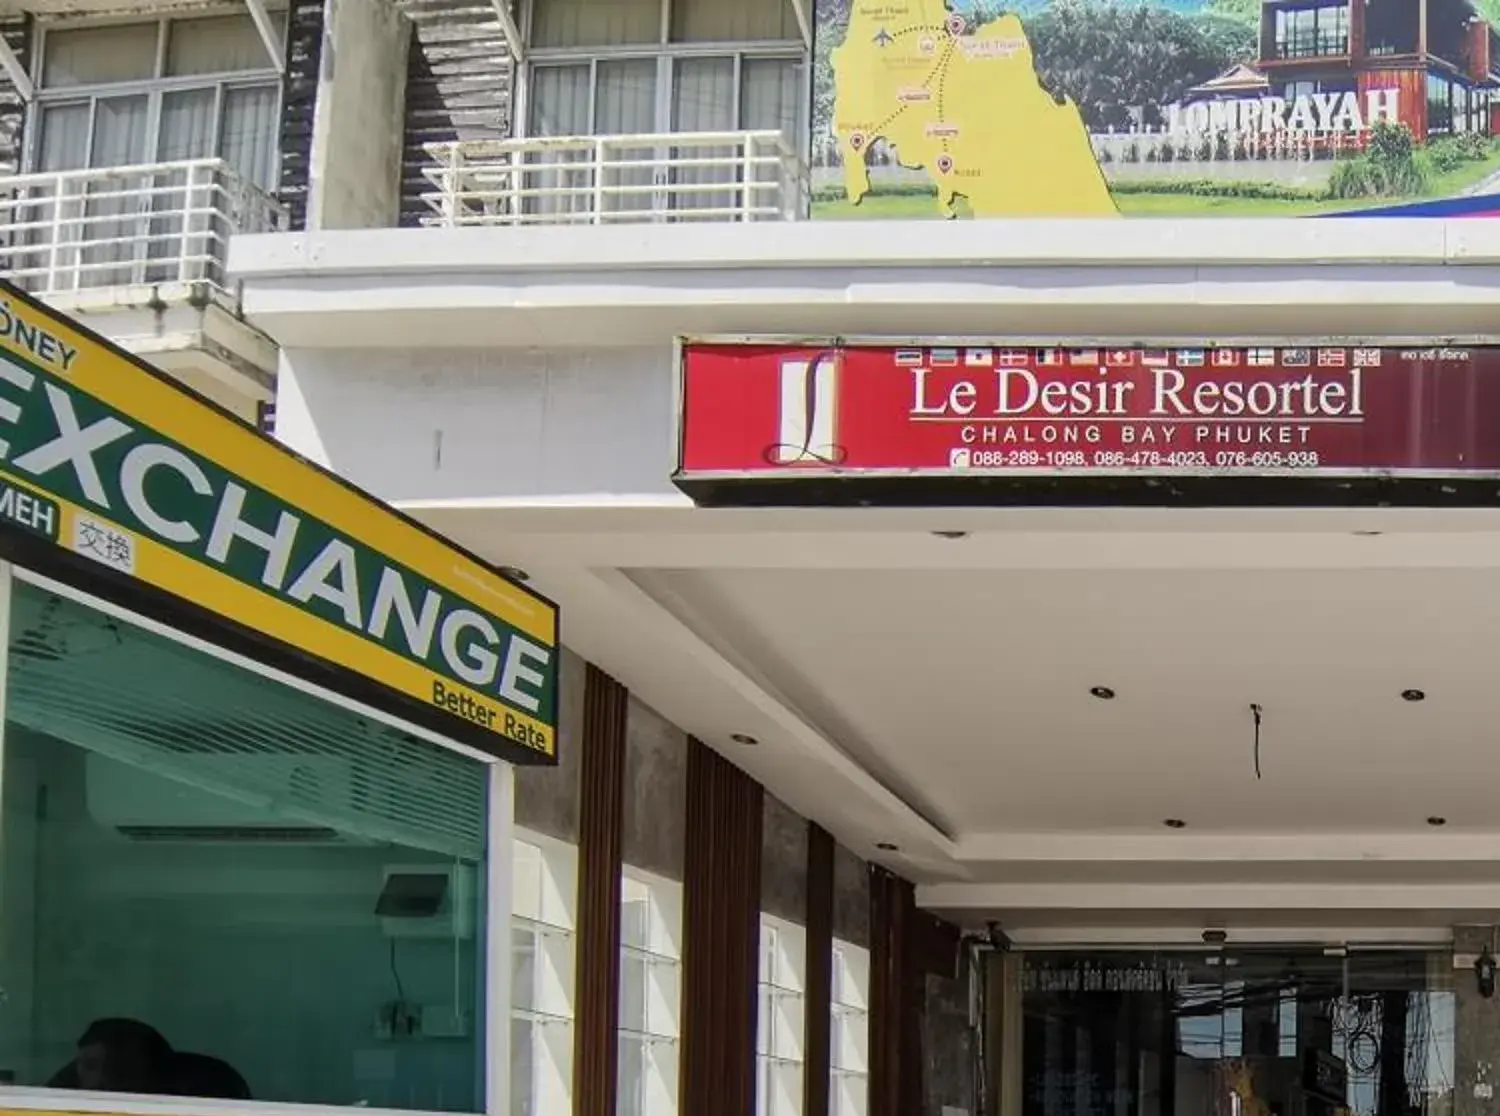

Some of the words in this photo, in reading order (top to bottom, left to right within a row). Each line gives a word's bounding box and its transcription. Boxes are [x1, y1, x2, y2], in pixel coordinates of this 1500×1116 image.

[1167, 88, 1400, 136] LOMPRAYAH
[909, 368, 977, 415] Le
[994, 366, 1135, 415] Desir
[1152, 367, 1366, 415] Resortel
[961, 425, 1101, 443] CHALONG
[1122, 425, 1177, 443] BAY
[1196, 425, 1312, 443] PHUKET
[0, 357, 549, 713] EXCHANGE
[432, 682, 496, 726] Better
[504, 713, 547, 750] Rate
